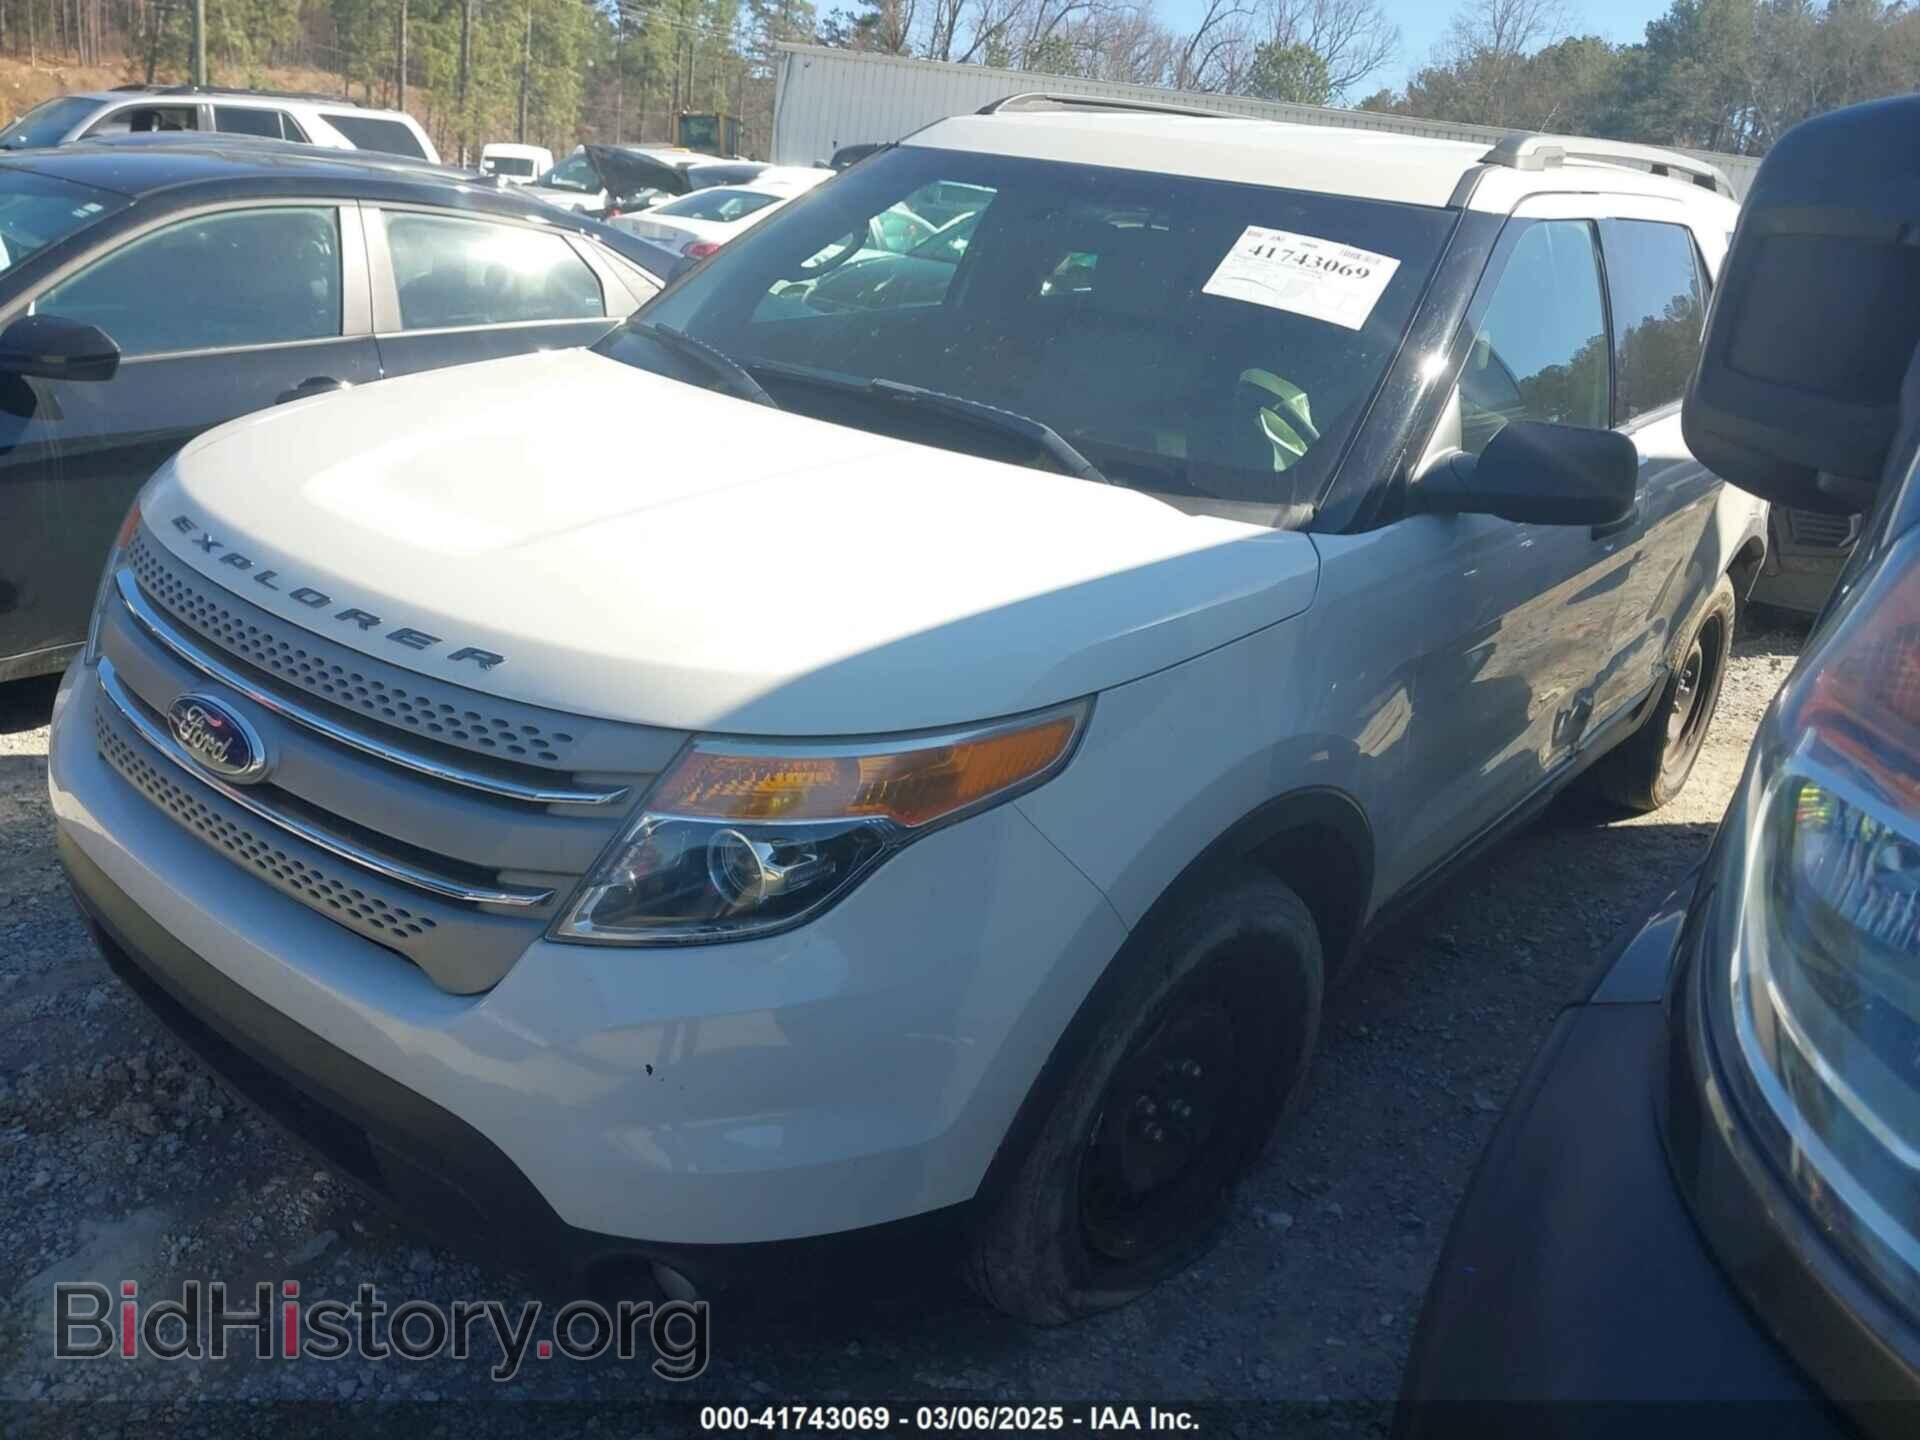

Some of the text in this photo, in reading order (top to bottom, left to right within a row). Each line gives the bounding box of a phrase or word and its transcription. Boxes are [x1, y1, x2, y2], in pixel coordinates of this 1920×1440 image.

[1248, 243, 1371, 279] 41743069
[171, 514, 507, 672] EXPLORER
[174, 705, 230, 763] Ford
